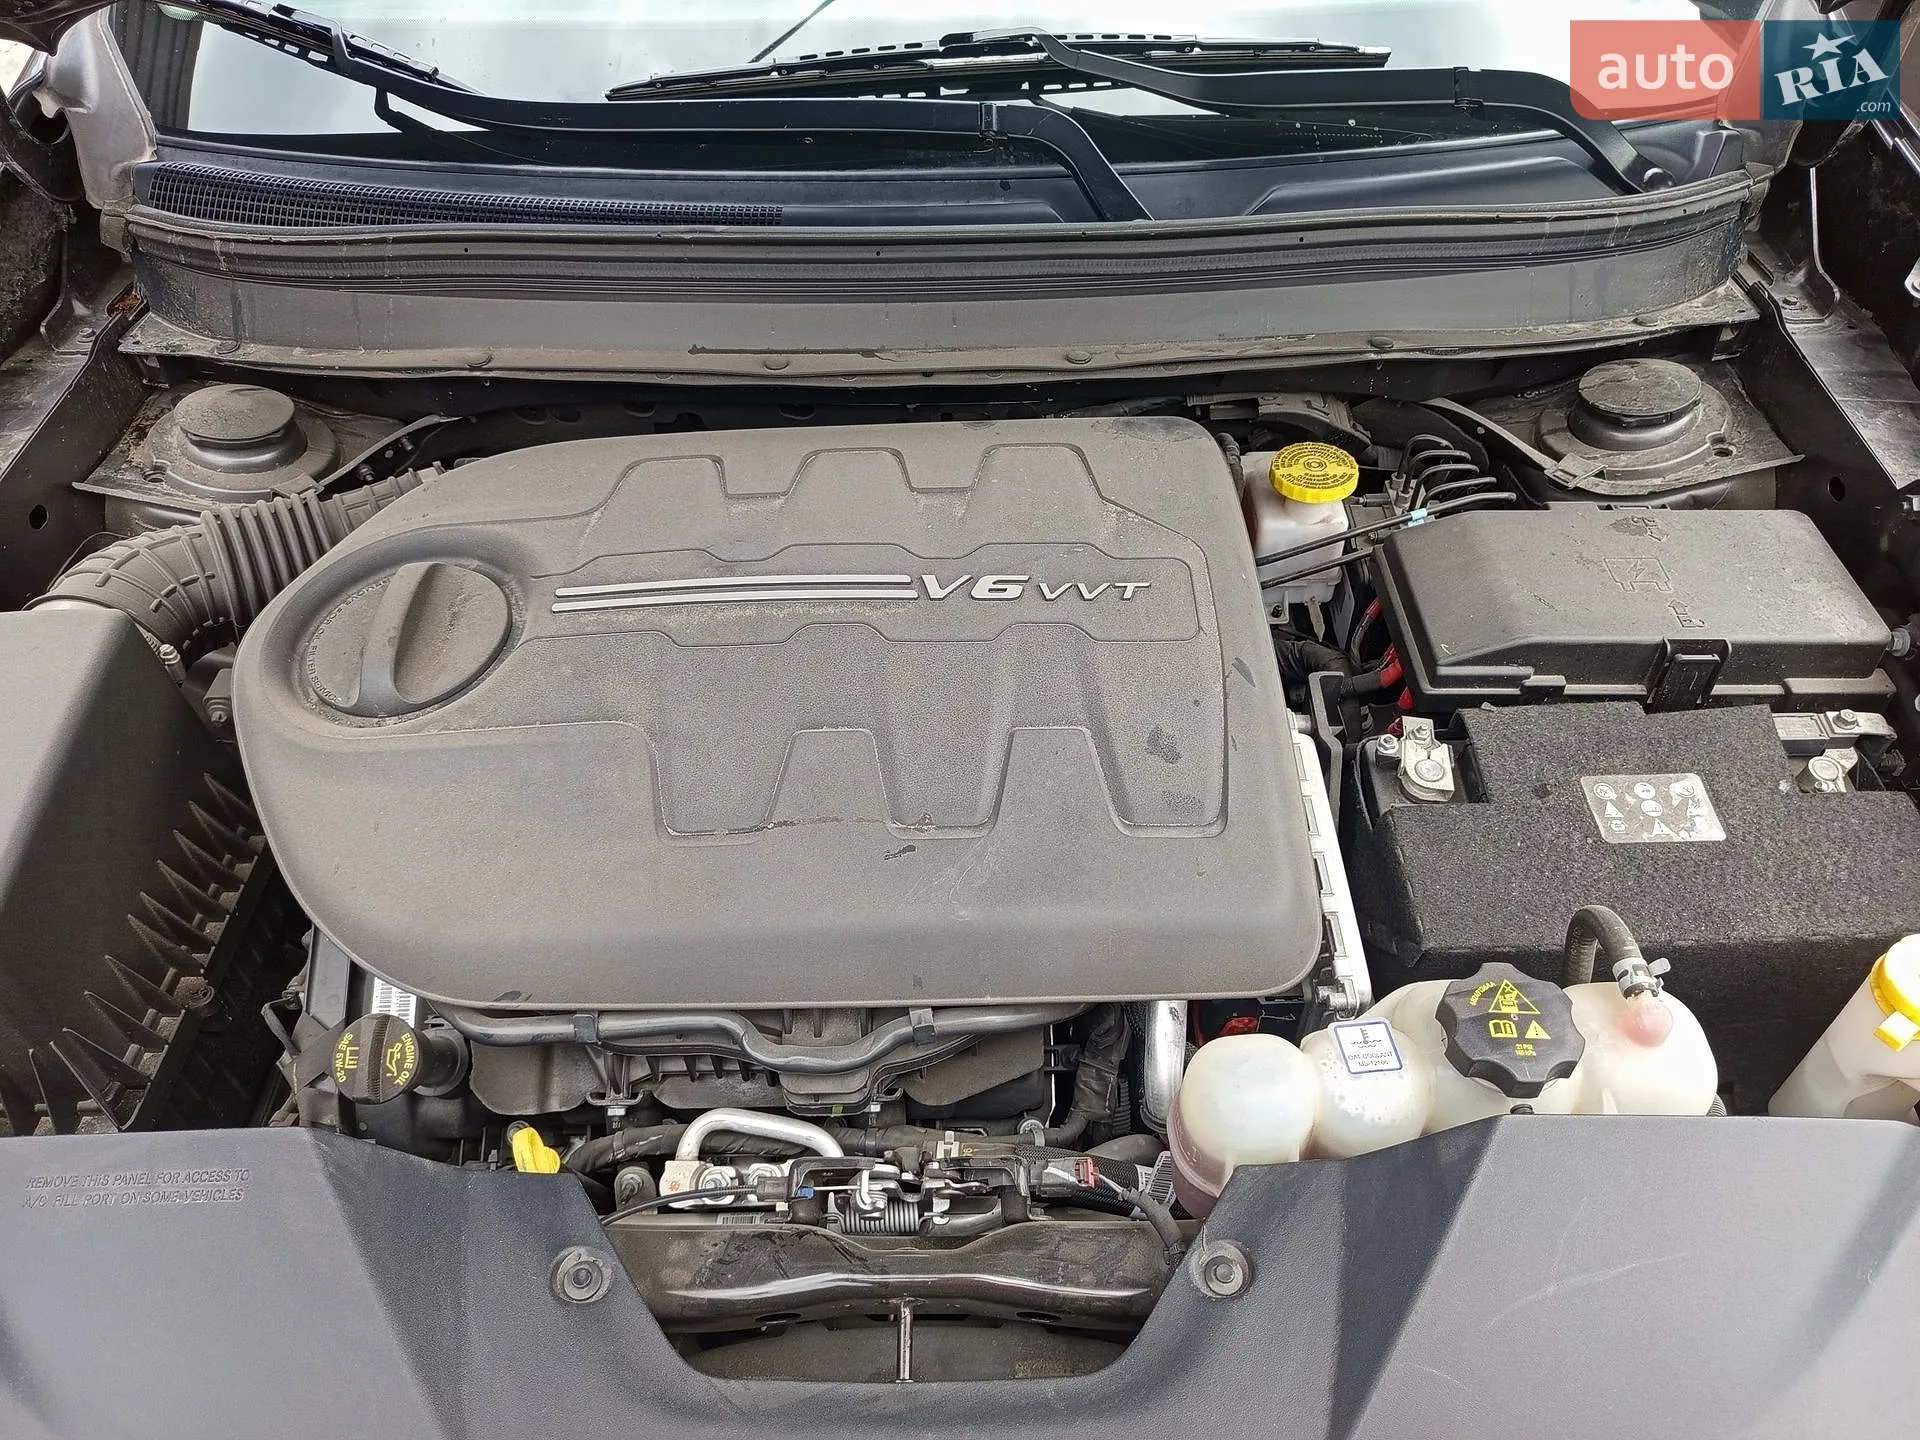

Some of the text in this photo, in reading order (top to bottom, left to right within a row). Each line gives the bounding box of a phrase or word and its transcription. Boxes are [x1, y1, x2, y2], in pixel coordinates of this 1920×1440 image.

[920, 573, 1152, 602] V6 VVT
[335, 1032, 354, 1083] SAE 5W-20
[394, 1032, 415, 1086] ENGINE OIL
[25, 1168, 251, 1189] REMOVE THIS PANEL FOR ACCESS TO
[22, 1188, 245, 1209] A/C FILL PORT ON SOME VEHICLES
